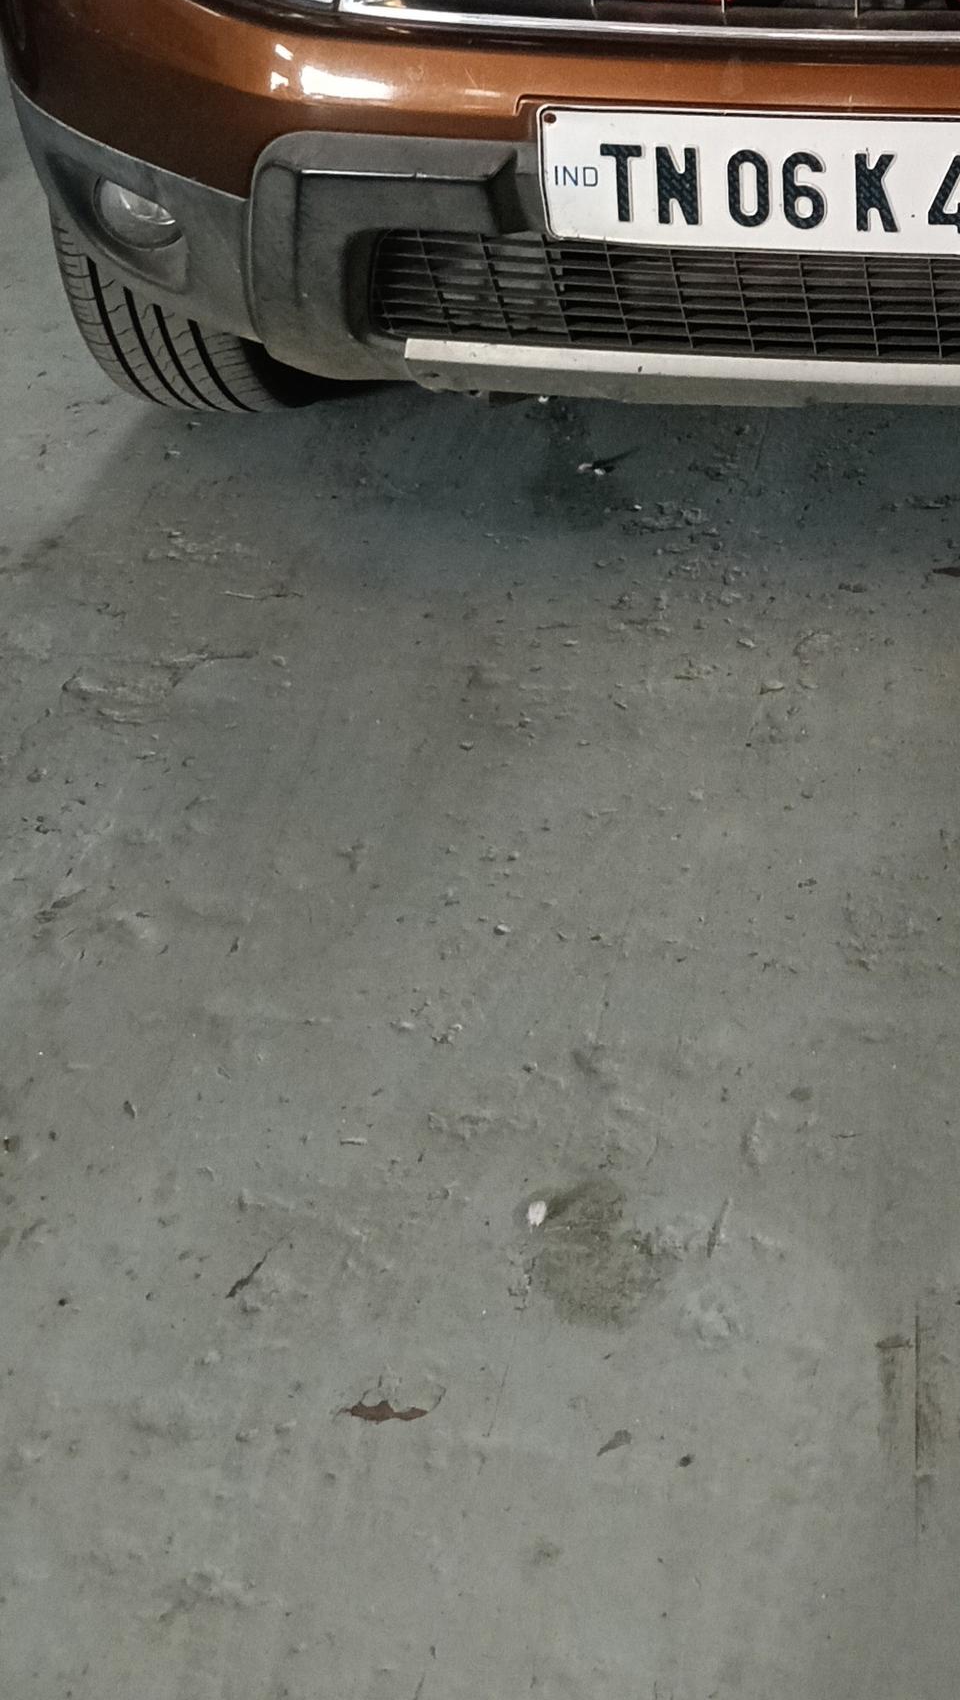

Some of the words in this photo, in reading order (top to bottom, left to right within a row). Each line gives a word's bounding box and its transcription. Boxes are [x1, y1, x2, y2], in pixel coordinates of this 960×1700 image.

[554, 165, 599, 187] IND
[600, 143, 700, 226] TN
[726, 148, 826, 230] 06
[854, 150, 899, 233] K
